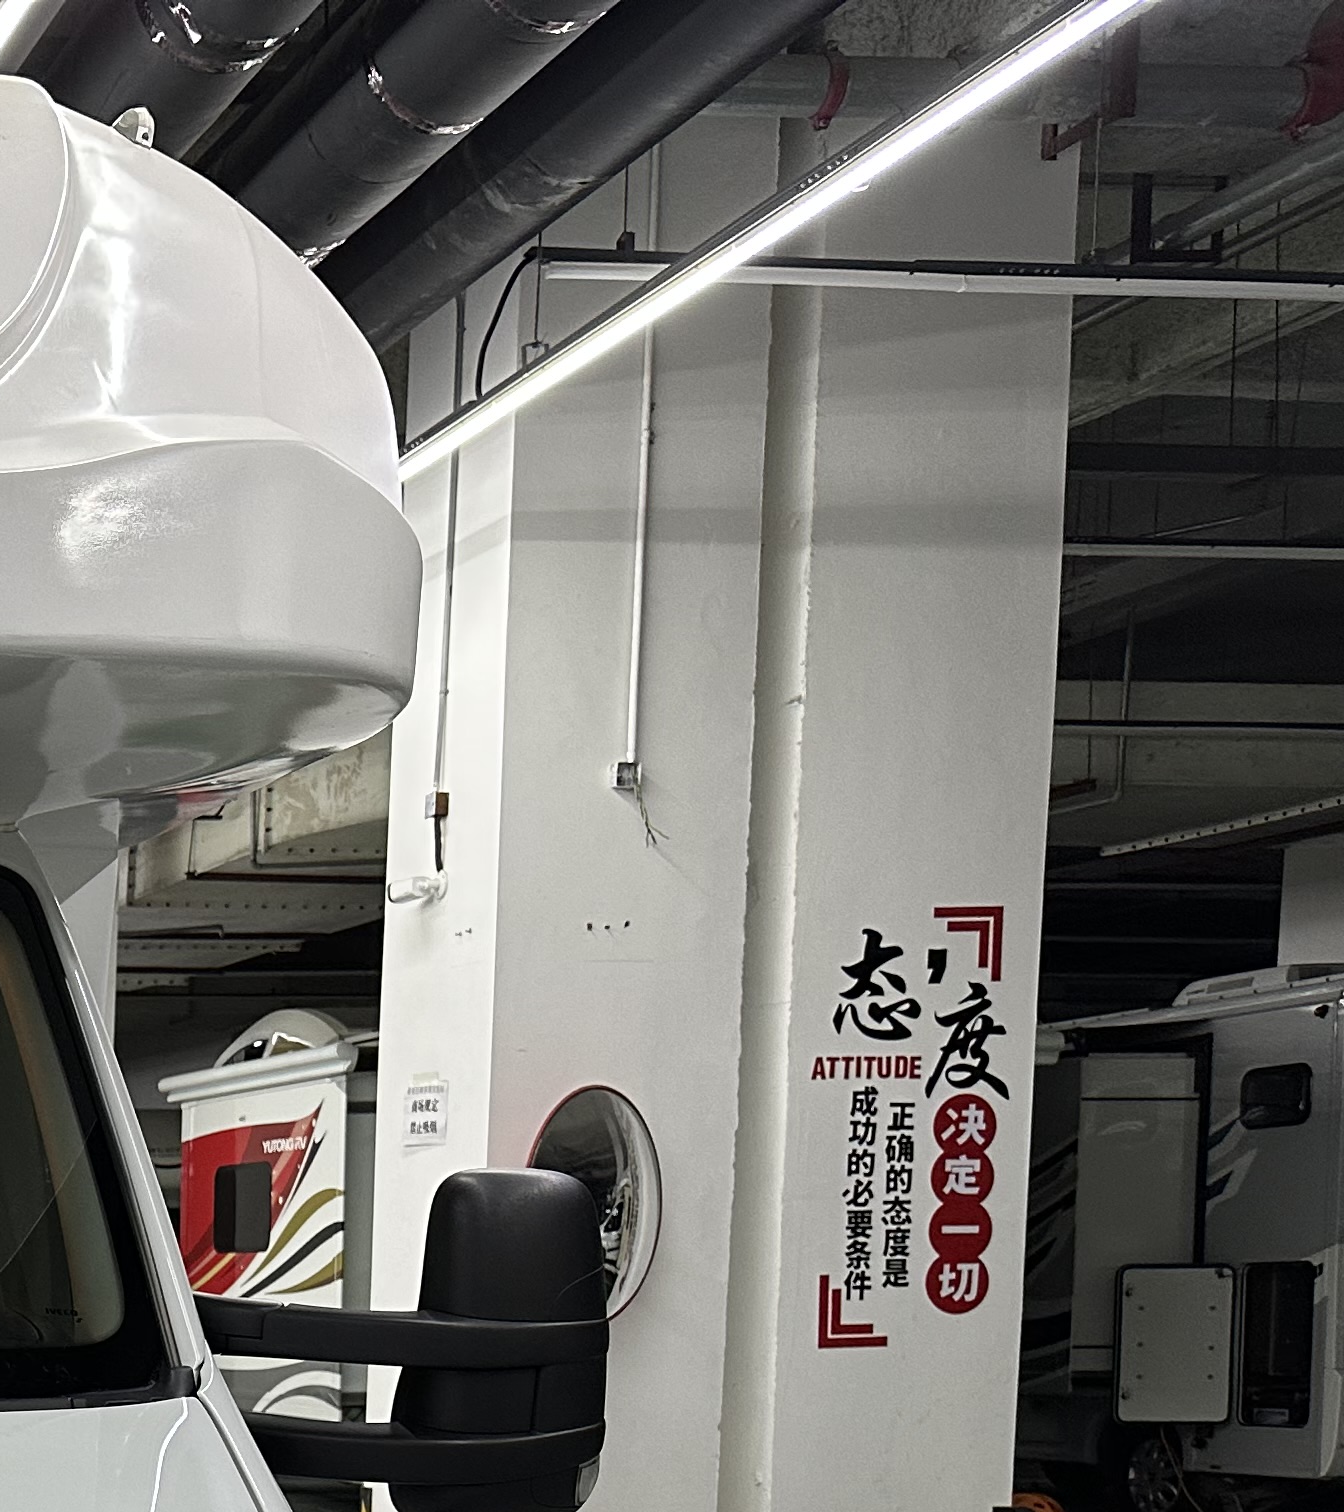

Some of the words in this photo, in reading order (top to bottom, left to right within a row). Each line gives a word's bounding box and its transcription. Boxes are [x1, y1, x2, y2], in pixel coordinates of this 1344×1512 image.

[262, 1137, 294, 1154] YUTONG
[811, 1055, 921, 1080] ATTITUDE
[842, 1085, 879, 1301] 成功的必要条件
[880, 1101, 915, 1289] 正确的态度是
[938, 1102, 987, 1303] 决定一切
